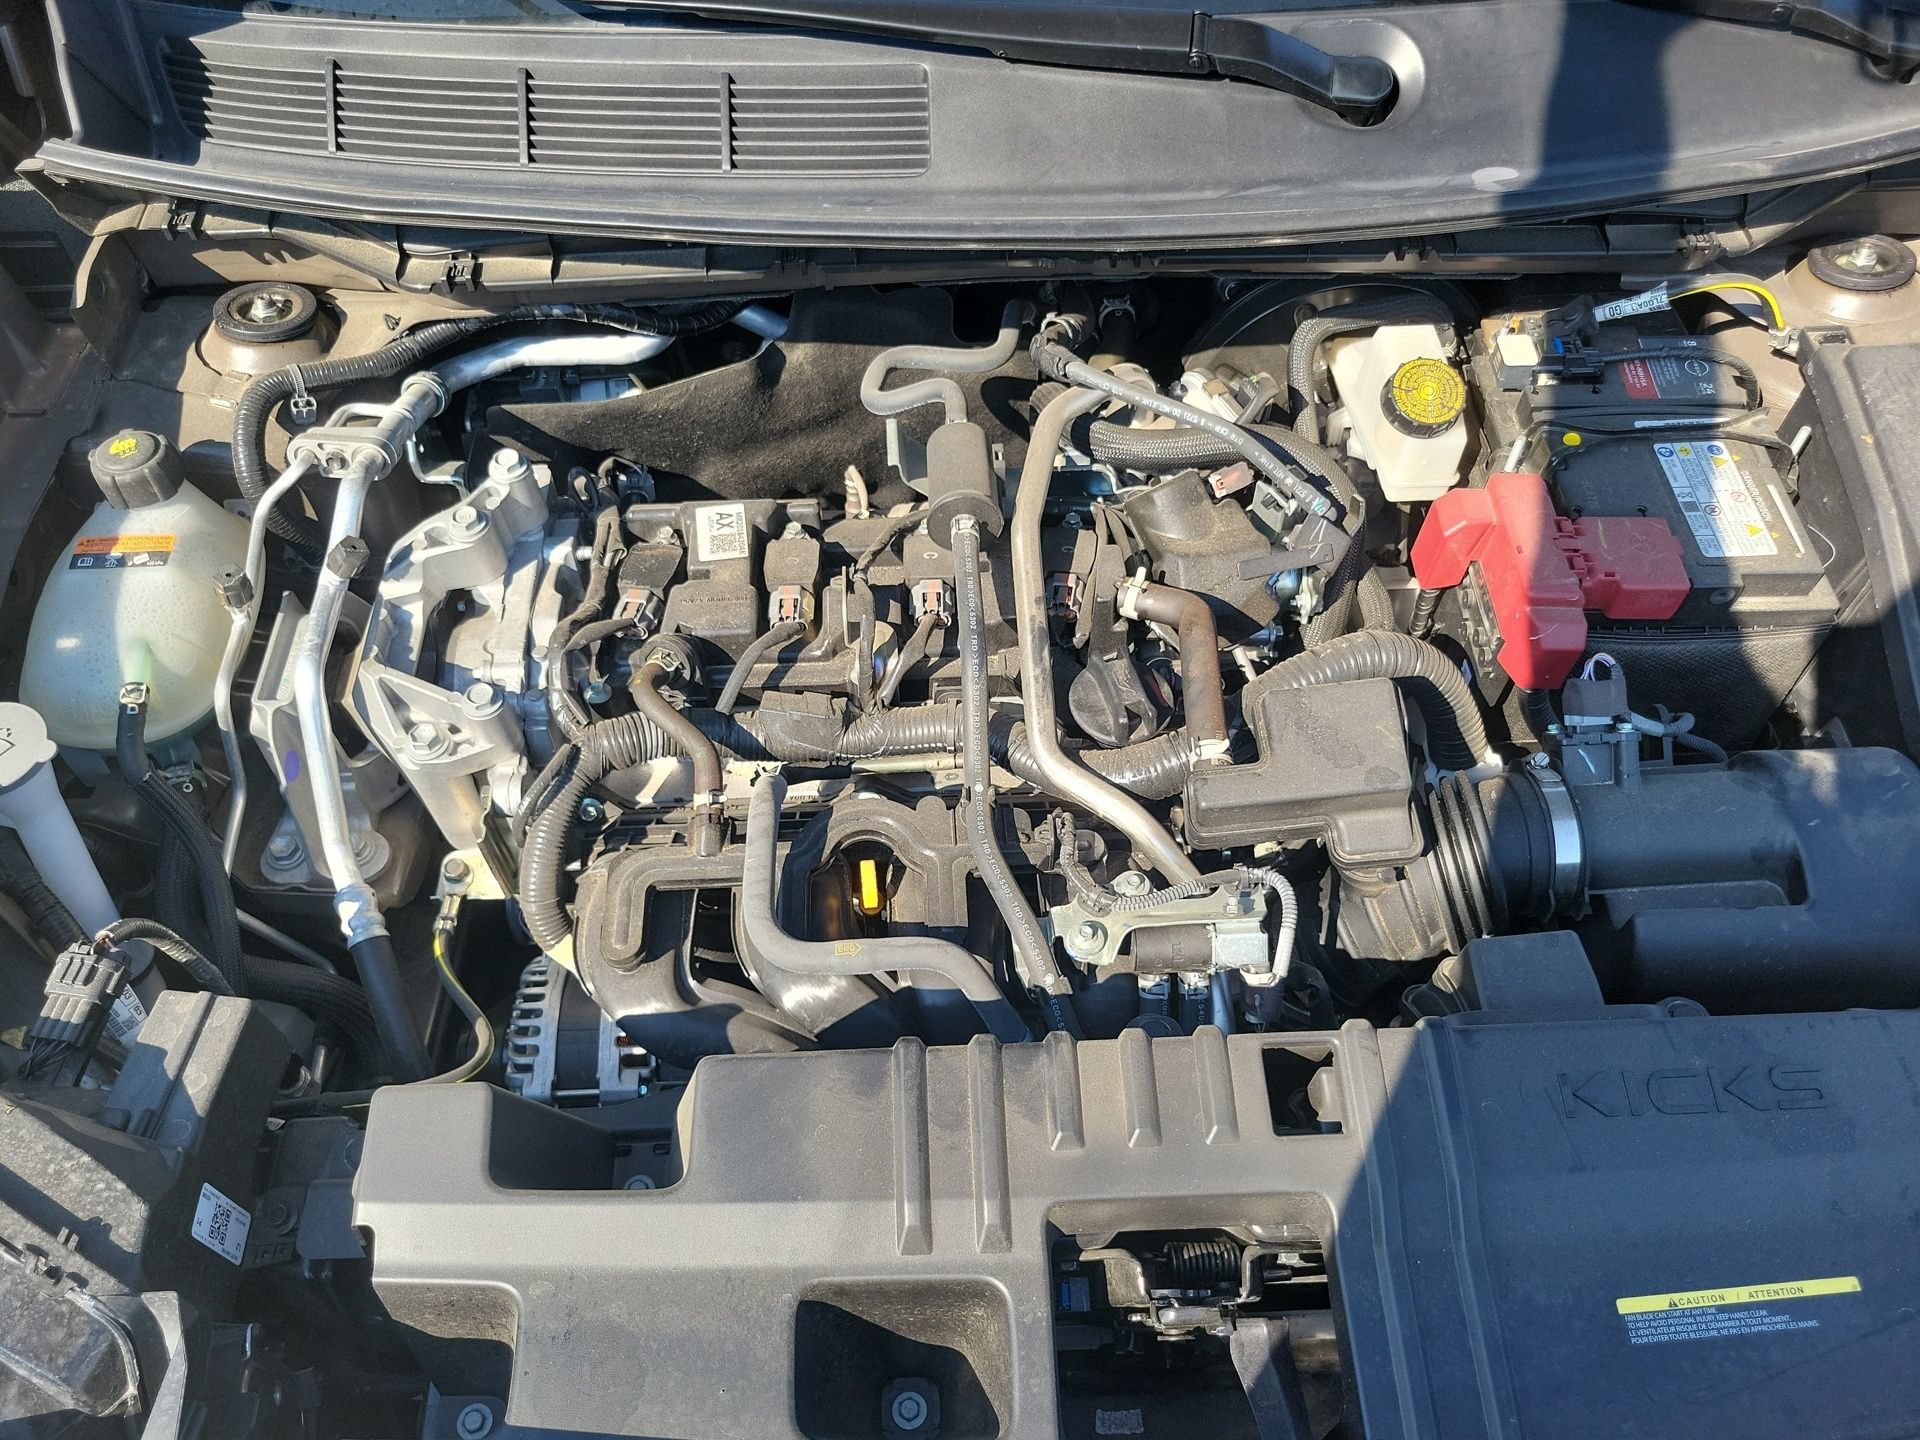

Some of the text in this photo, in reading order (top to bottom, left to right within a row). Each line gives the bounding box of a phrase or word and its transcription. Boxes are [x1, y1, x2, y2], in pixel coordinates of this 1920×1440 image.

[715, 512, 735, 531] AX
[1556, 1063, 1827, 1118] KICKS
[1679, 1294, 1725, 1306] CAUTION
[1748, 1287, 1804, 1300] ATTENTION
[1637, 1326, 1675, 1336] VENTILATEUR
[1676, 1324, 1697, 1332] RISQUE
[1746, 1317, 1761, 1325] TOUT
[1668, 1317, 1695, 1325] PERSONAL
[1729, 1311, 1748, 1319] HANDS
[1631, 1337, 1648, 1345] POUR
[1669, 1333, 1688, 1341] TOUTE
[1750, 1323, 1786, 1332] APPROCHER
